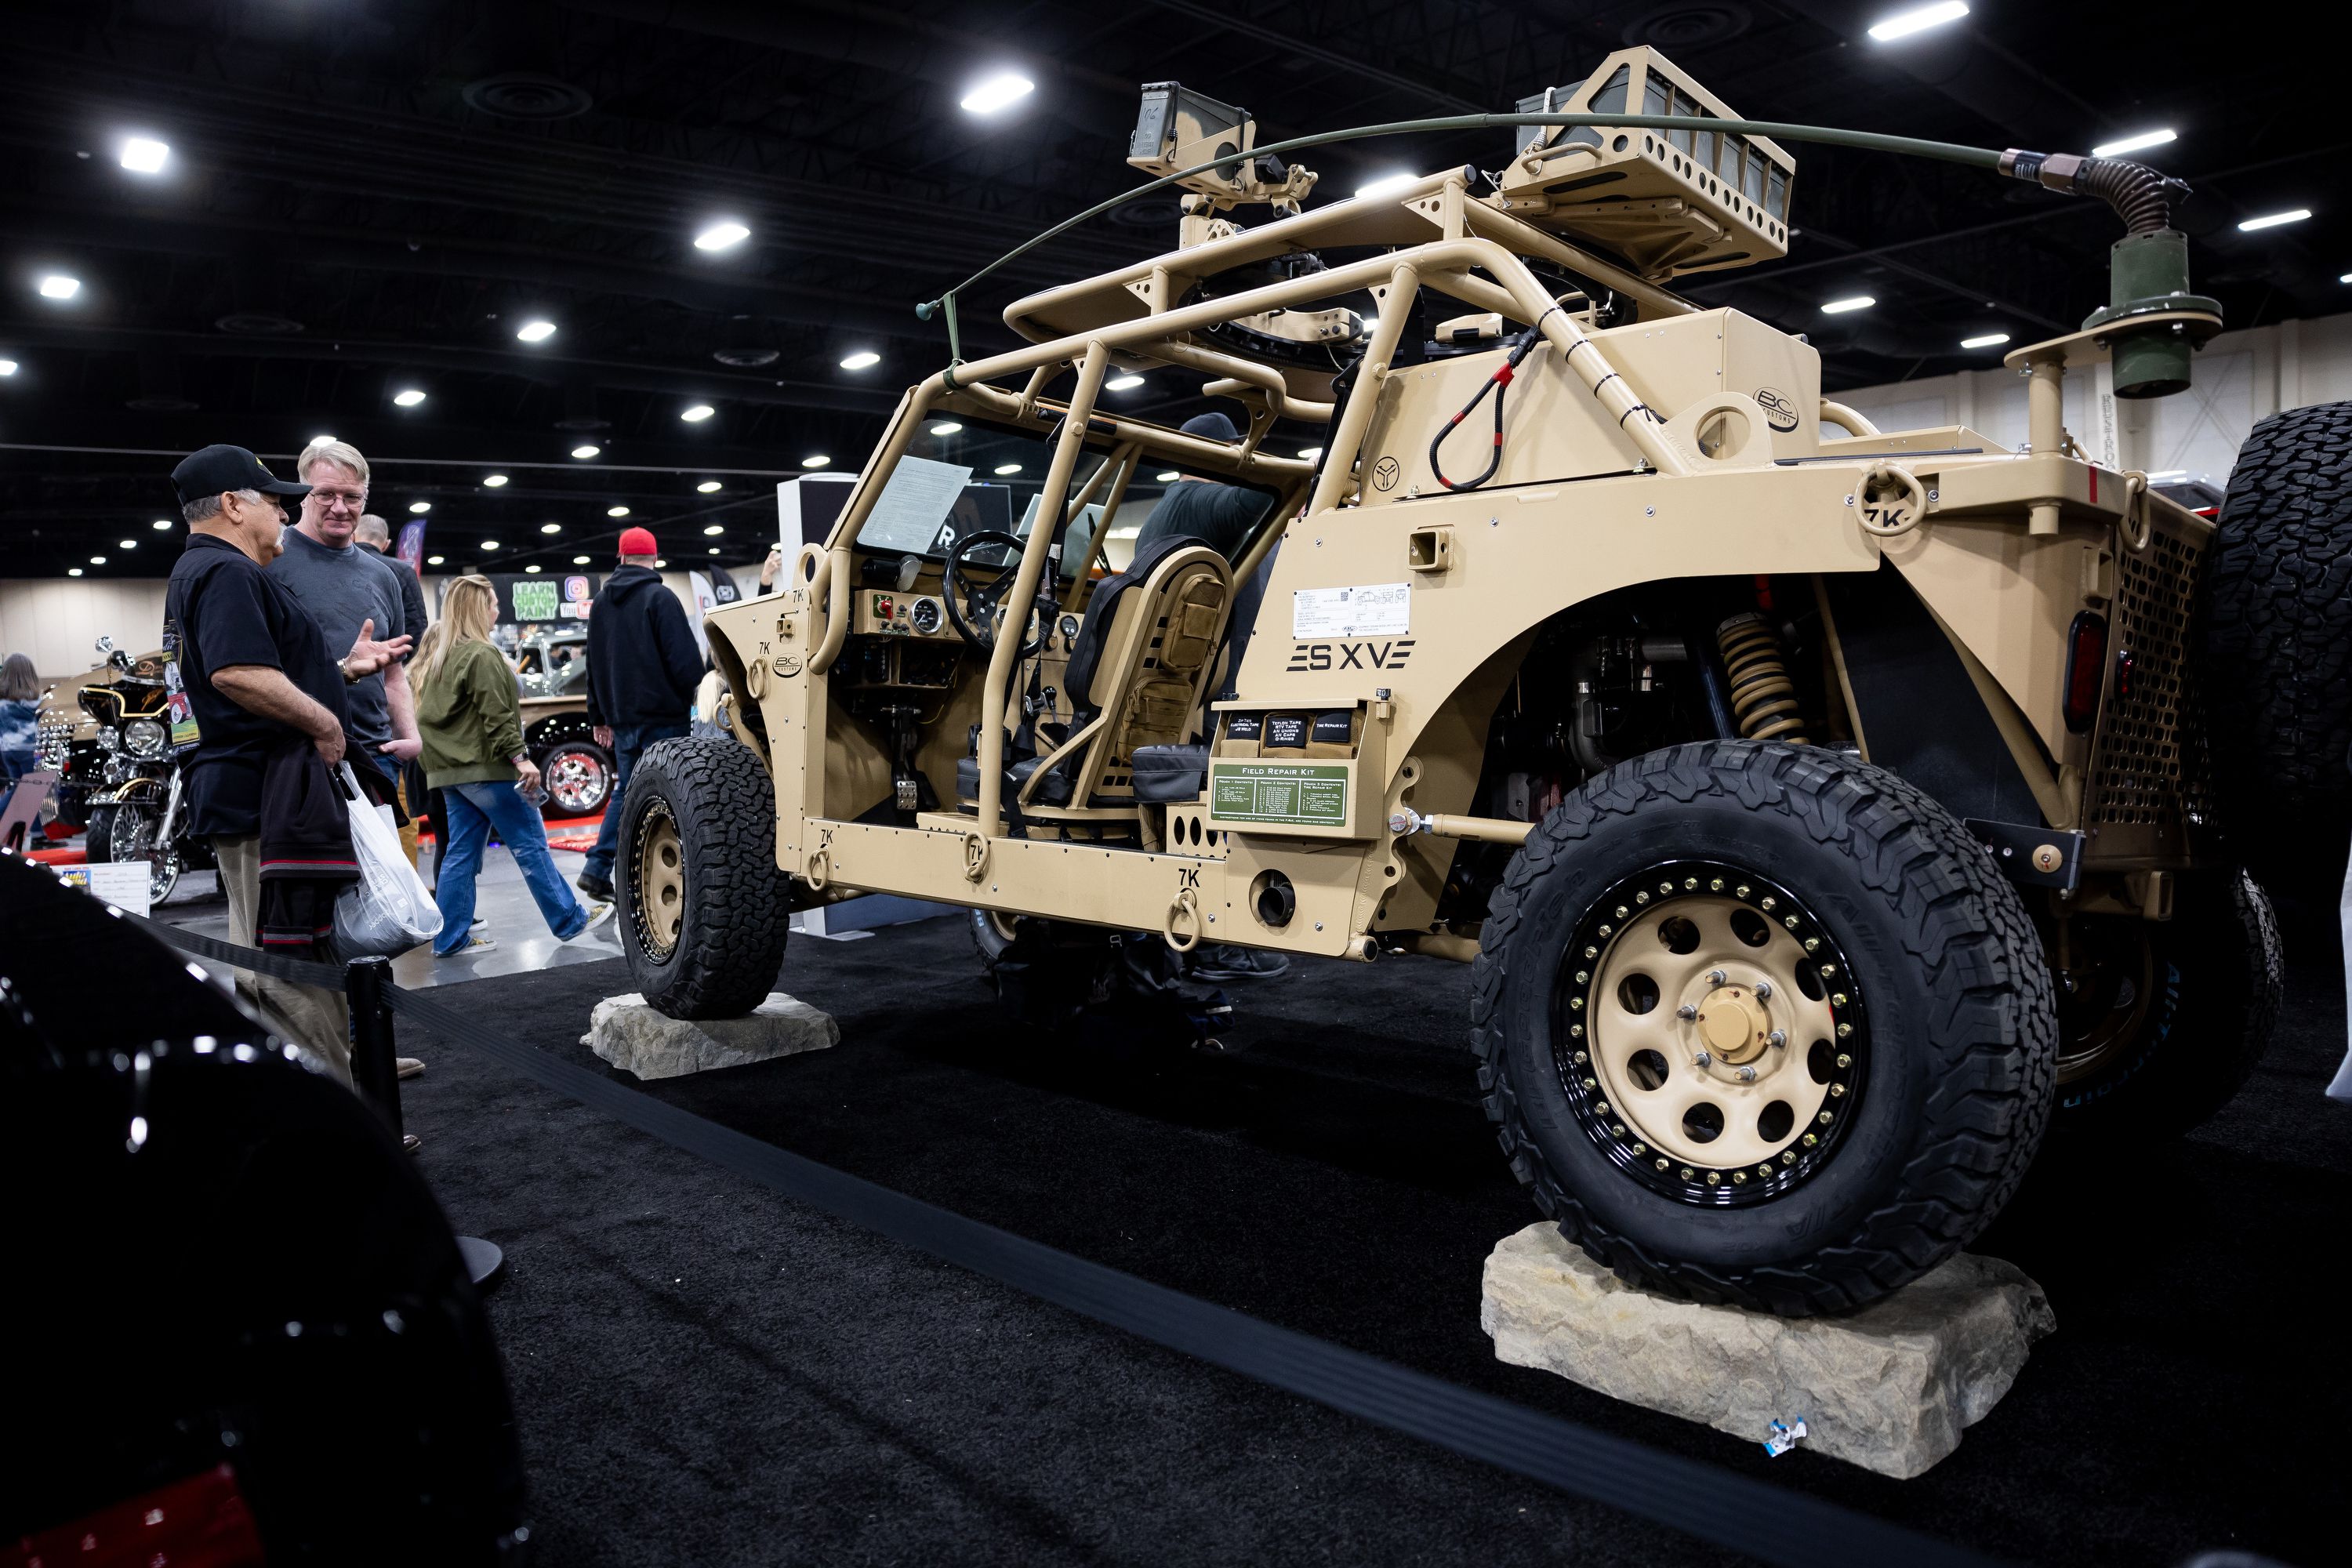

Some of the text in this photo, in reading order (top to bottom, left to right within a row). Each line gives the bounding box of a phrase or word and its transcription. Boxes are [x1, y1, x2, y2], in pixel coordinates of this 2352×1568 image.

[1758, 390, 1793, 414] BC
[514, 582, 556, 595] LEARN
[793, 588, 804, 603] 7K
[516, 607, 556, 620] PAINT
[759, 642, 770, 655] 7K
[775, 657, 798, 666] BC
[821, 829, 833, 844] 7K
[1178, 868, 1200, 887] 7K
